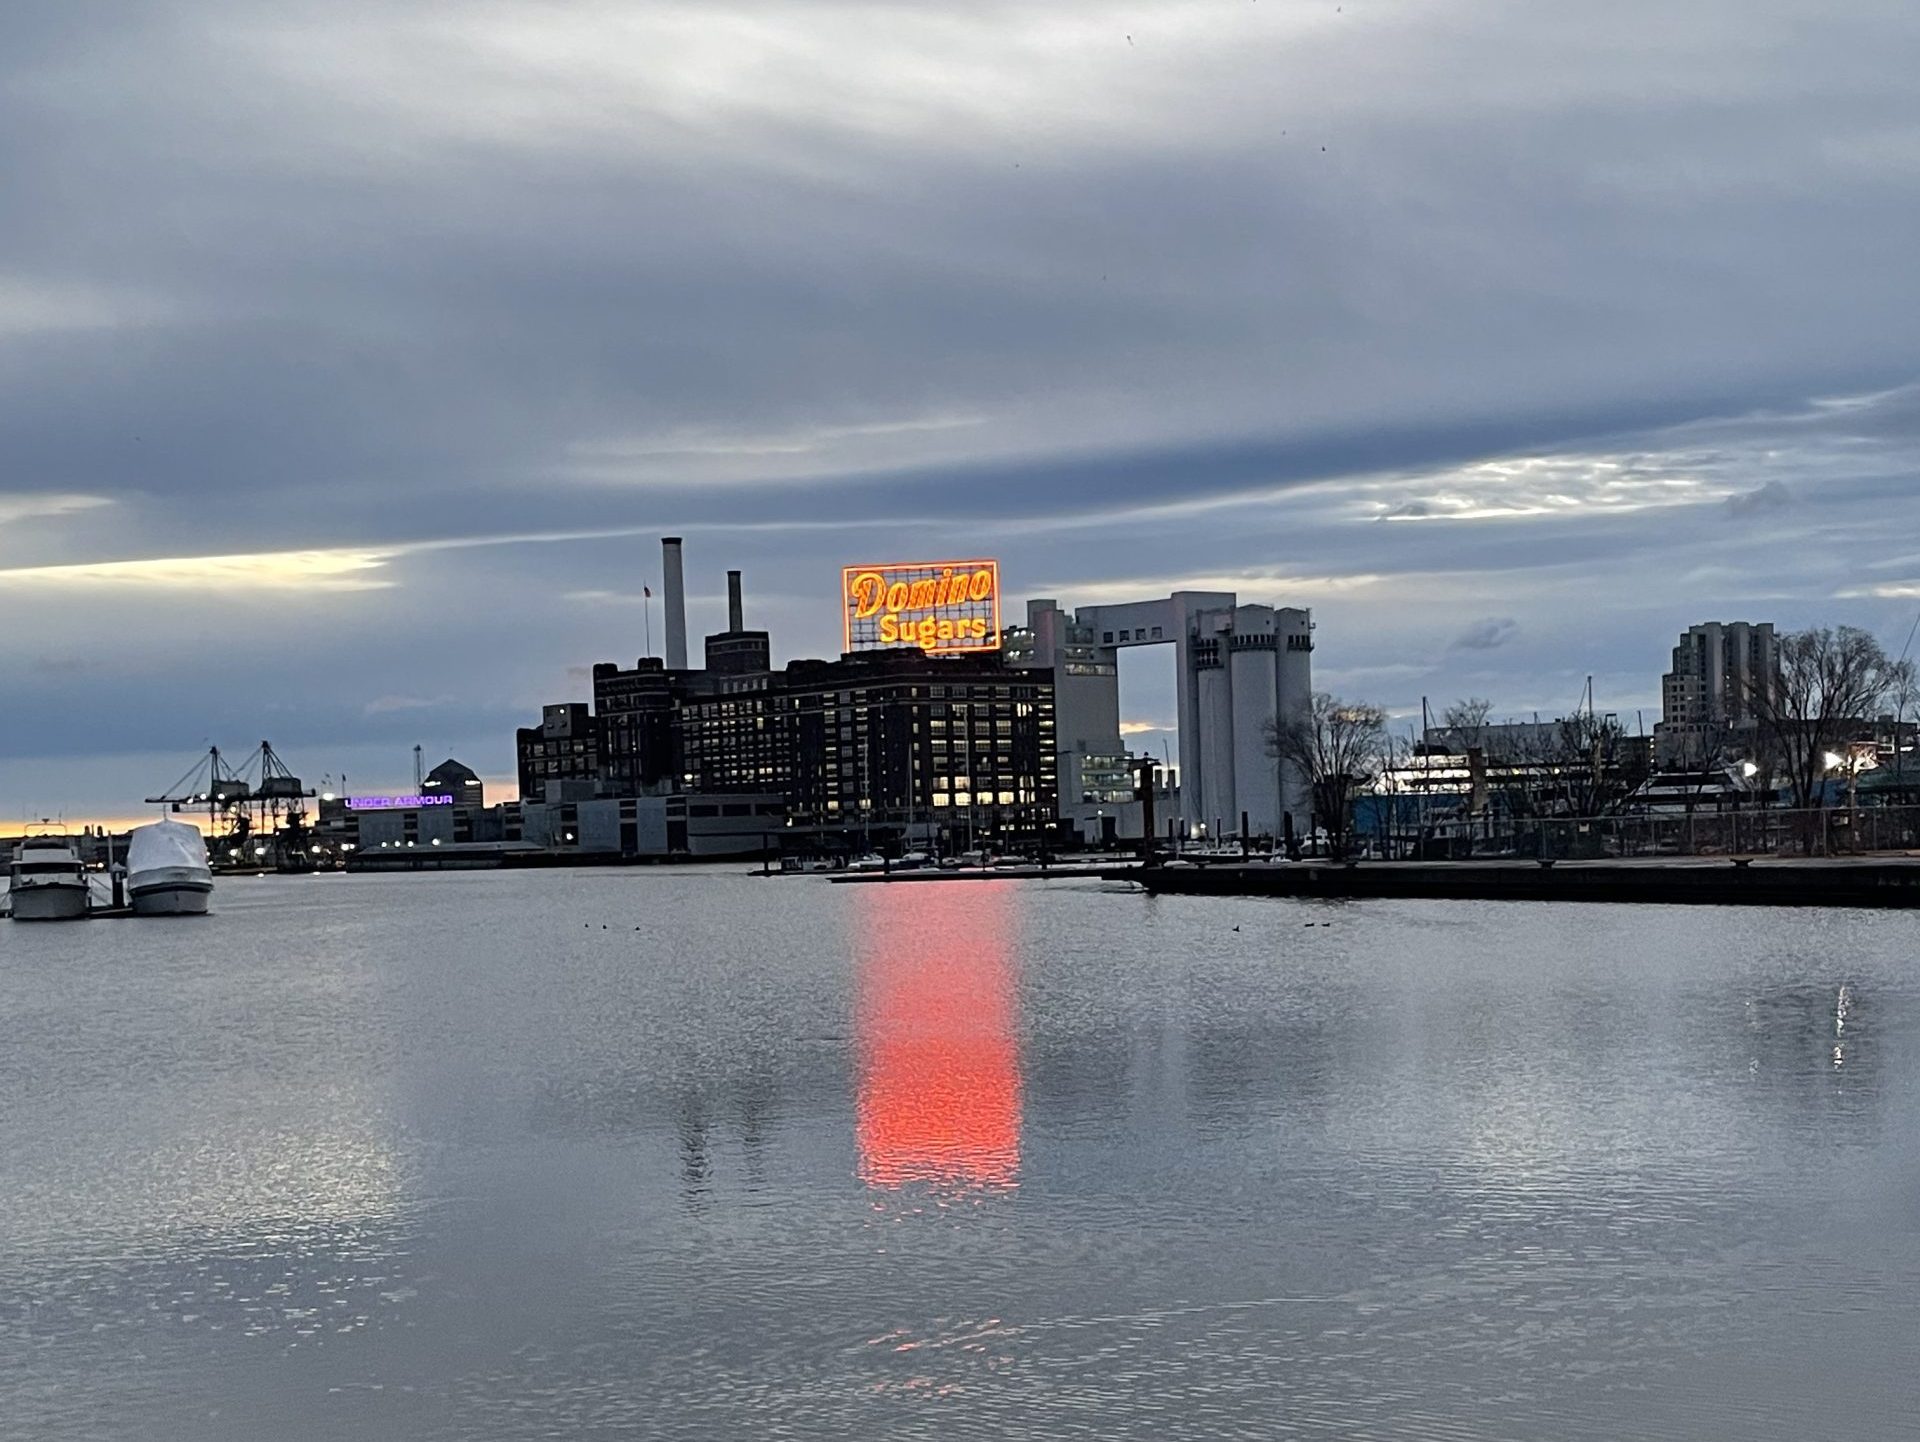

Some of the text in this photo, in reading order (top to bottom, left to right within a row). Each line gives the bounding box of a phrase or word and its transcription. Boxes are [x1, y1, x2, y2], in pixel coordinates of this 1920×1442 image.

[851, 568, 992, 618] Domino
[879, 614, 986, 650] Sugars
[344, 795, 453, 808] UNDER ARMOUR
